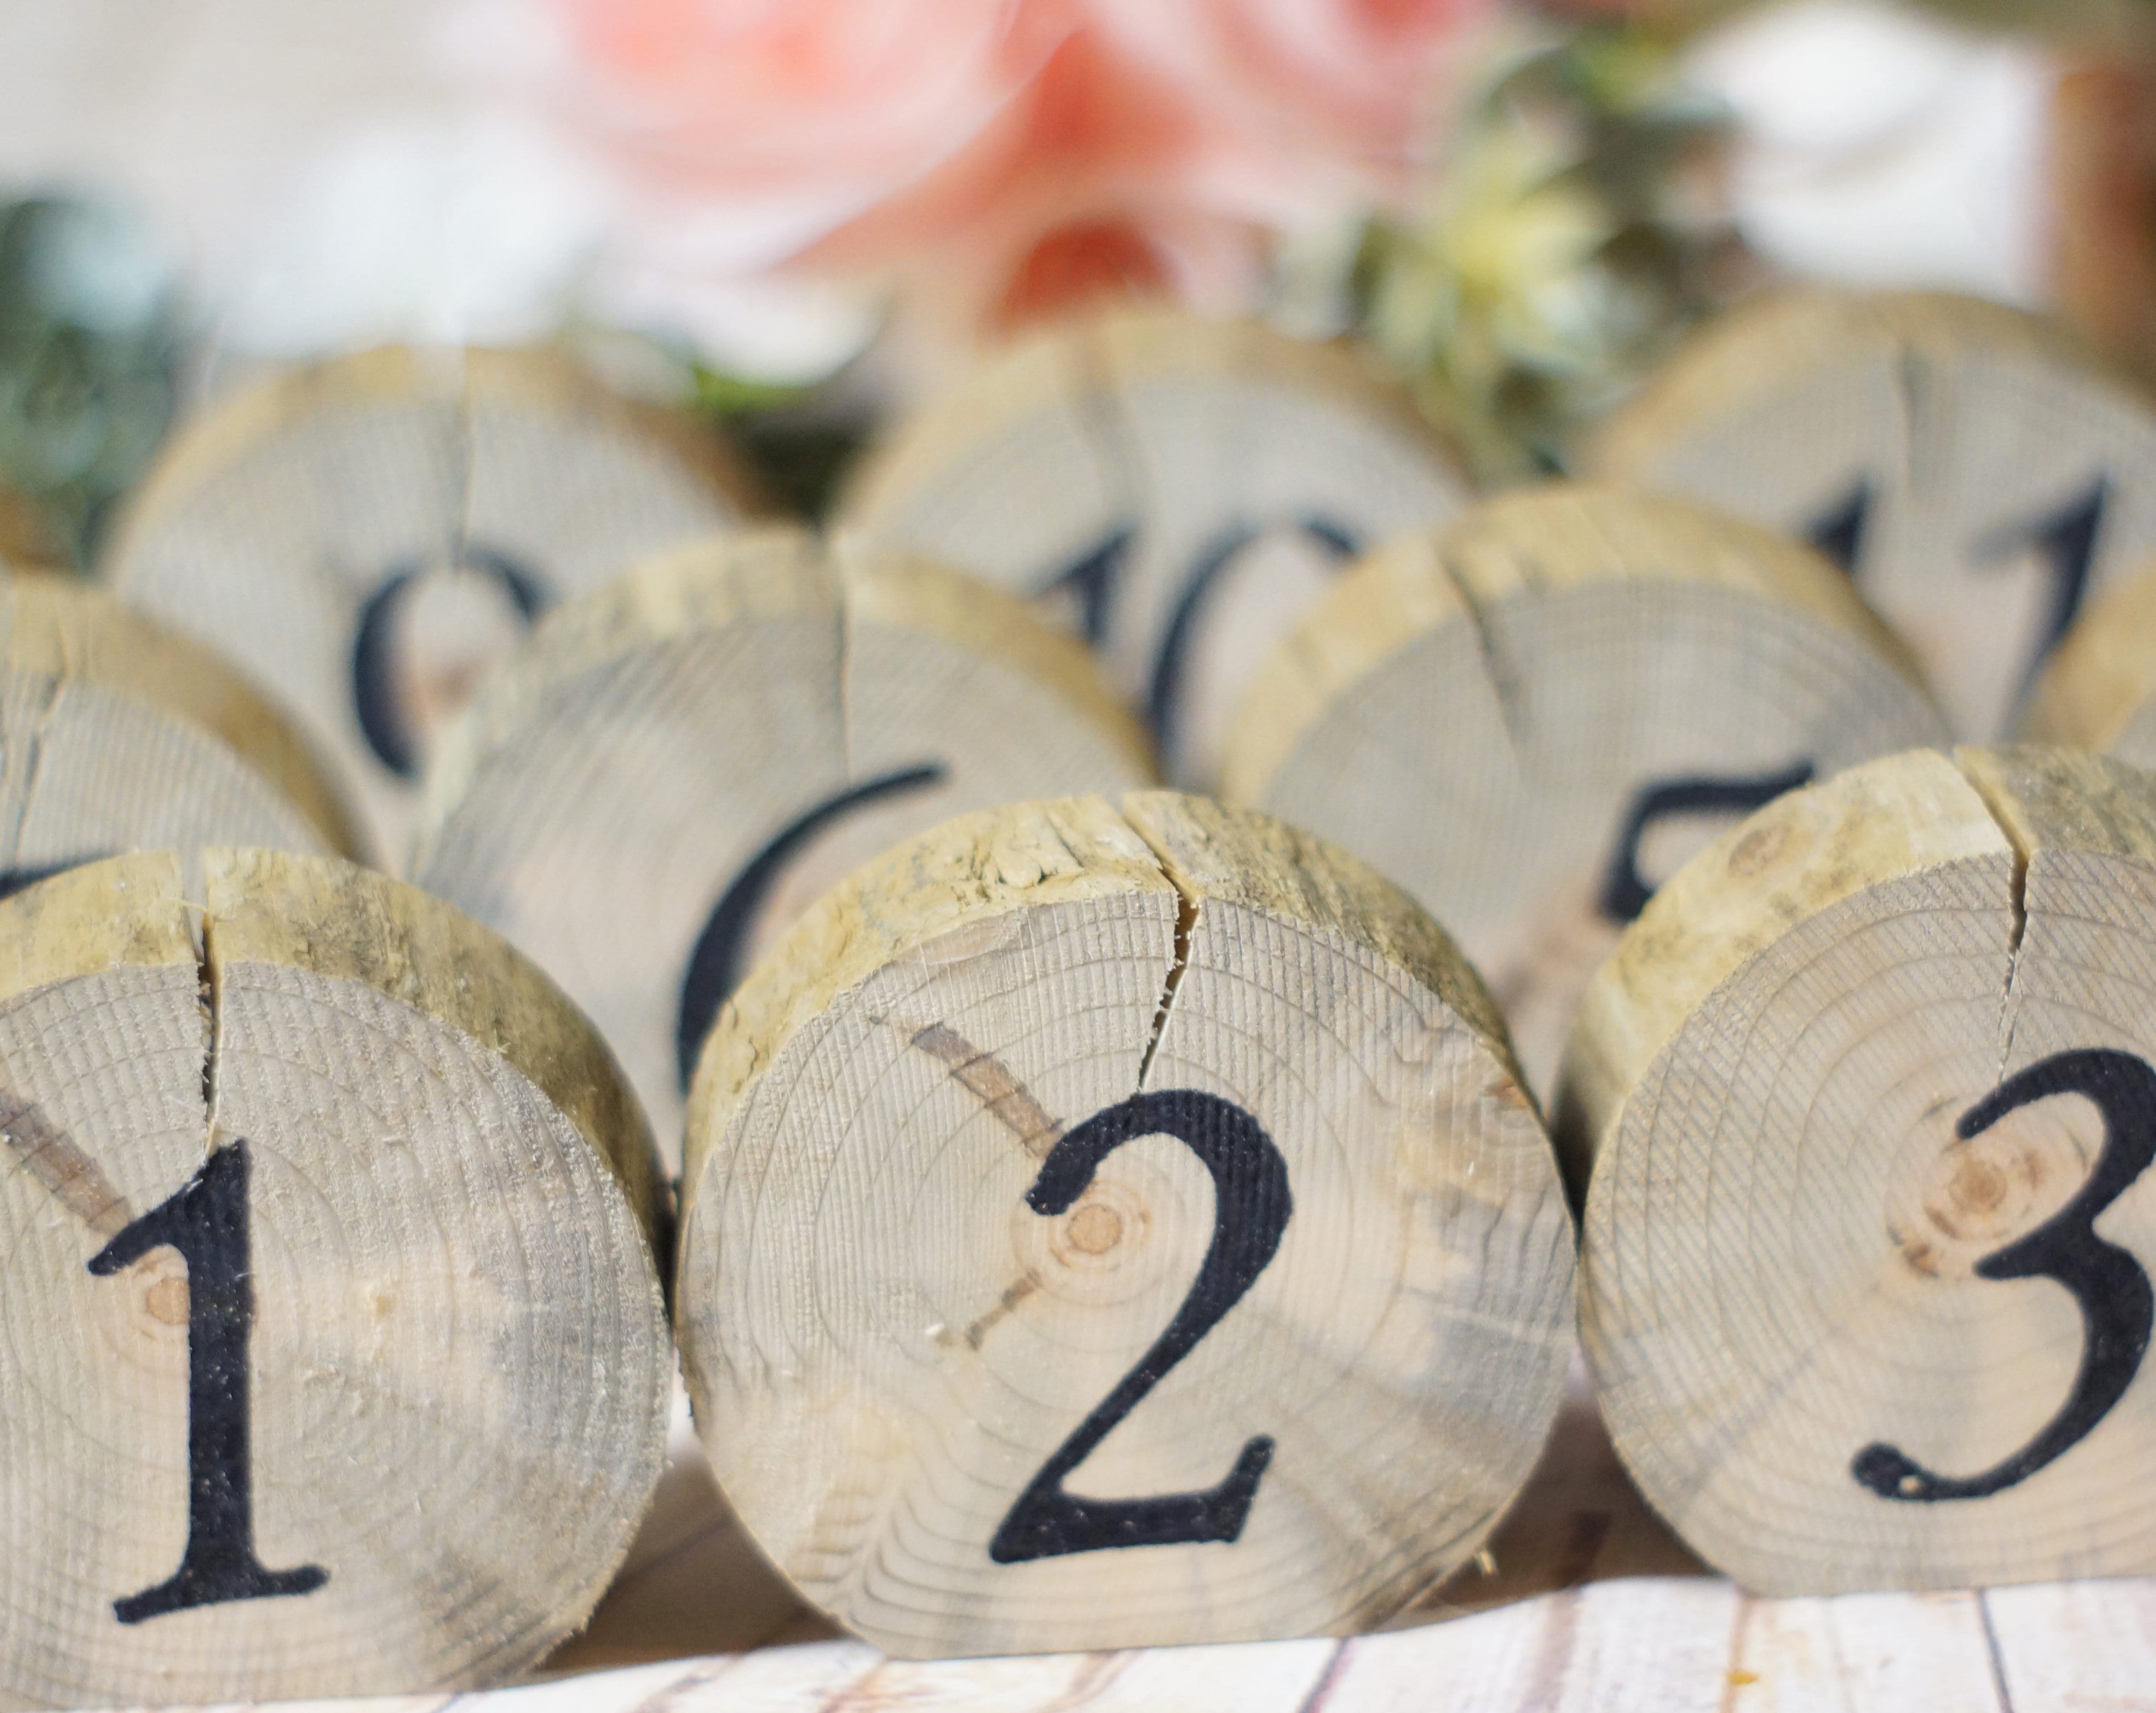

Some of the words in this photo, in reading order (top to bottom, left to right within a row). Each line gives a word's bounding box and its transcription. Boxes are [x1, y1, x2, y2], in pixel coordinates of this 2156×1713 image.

[88, 1140, 329, 1624] 1
[989, 1088, 1294, 1564] 2
[1851, 1048, 2156, 1502] 3
